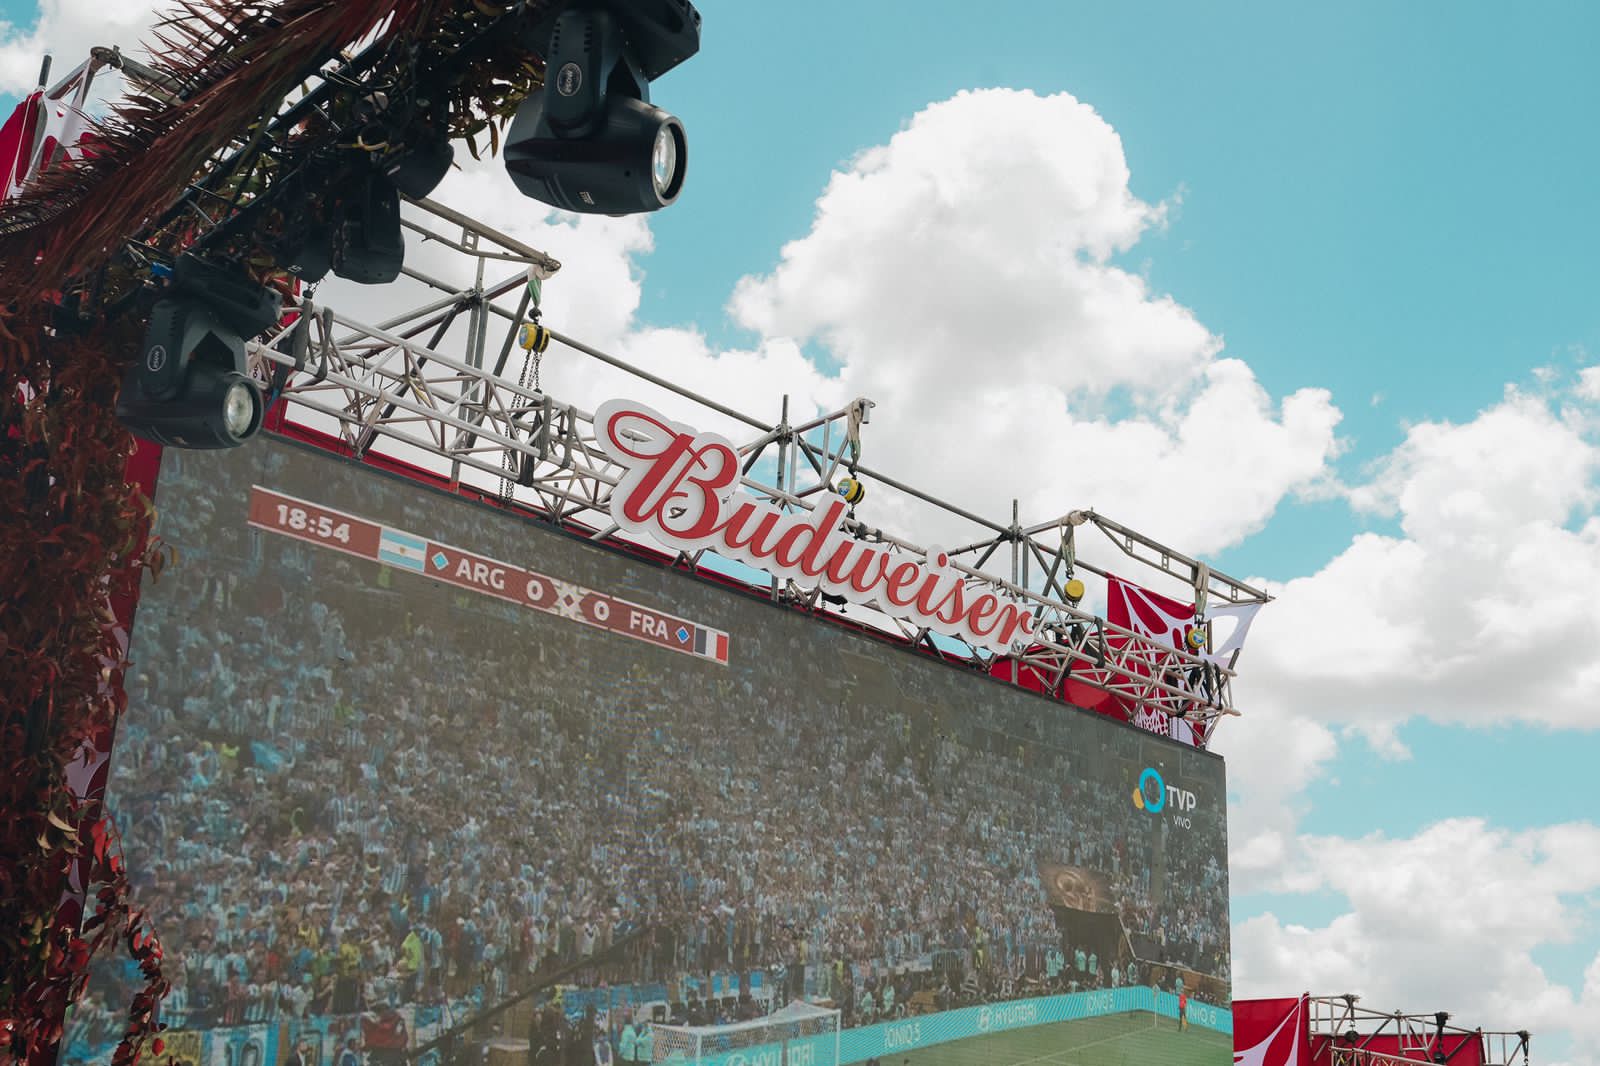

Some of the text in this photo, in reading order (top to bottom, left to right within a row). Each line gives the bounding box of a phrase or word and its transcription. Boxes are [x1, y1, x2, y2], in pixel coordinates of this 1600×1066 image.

[606, 410, 1035, 646] Budweiser
[276, 503, 351, 543] 18:54
[455, 558, 505, 590] ARG
[629, 610, 669, 640] FRA
[1166, 785, 1196, 811] TVP
[1173, 815, 1192, 830] VIVO
